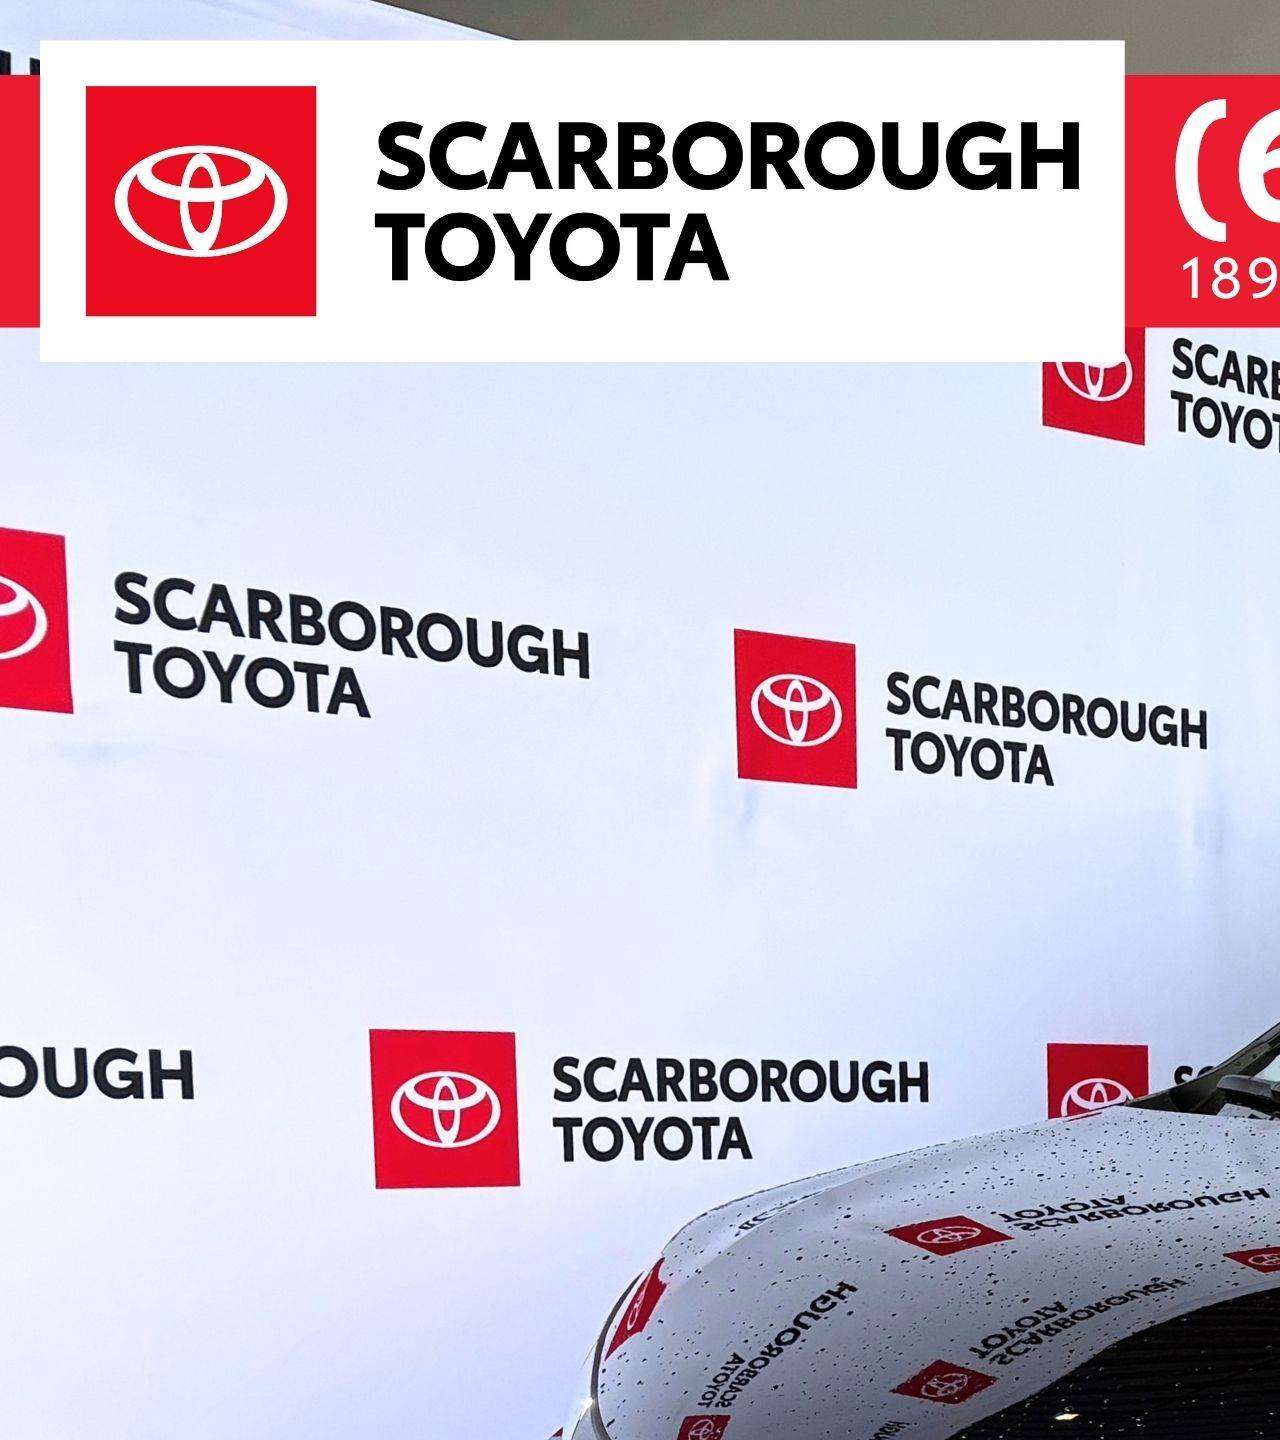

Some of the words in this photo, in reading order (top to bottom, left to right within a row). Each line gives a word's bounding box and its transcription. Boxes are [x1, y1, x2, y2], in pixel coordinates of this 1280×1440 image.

[114, 571, 590, 680] SCARBOROUGH
[113, 639, 372, 719] TOYOTA
[886, 671, 1208, 750] SCARBOROUGH
[885, 727, 1055, 787] TOYOTA
[0, 1045, 195, 1100] OUGH
[553, 1056, 930, 1103] SCARBOROUGH
[552, 1116, 753, 1163] TOYOTA
